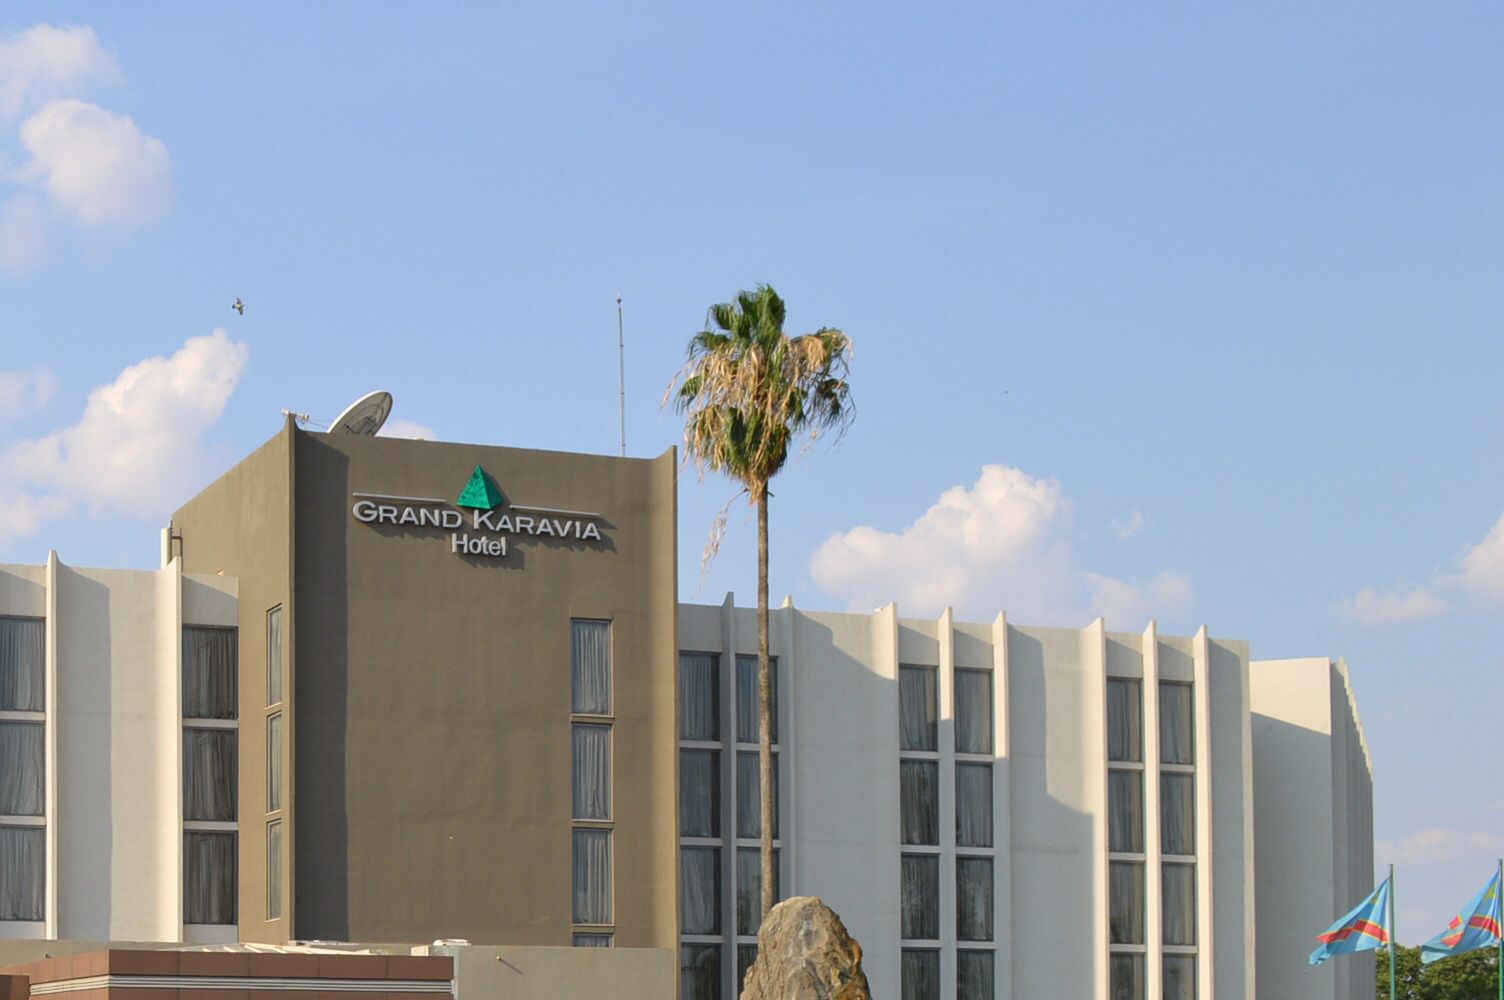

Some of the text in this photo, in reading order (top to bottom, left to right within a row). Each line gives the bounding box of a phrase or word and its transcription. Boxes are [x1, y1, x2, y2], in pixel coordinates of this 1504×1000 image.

[352, 500, 601, 541] GRAND KARAVIA
[451, 533, 507, 556] Hotel
